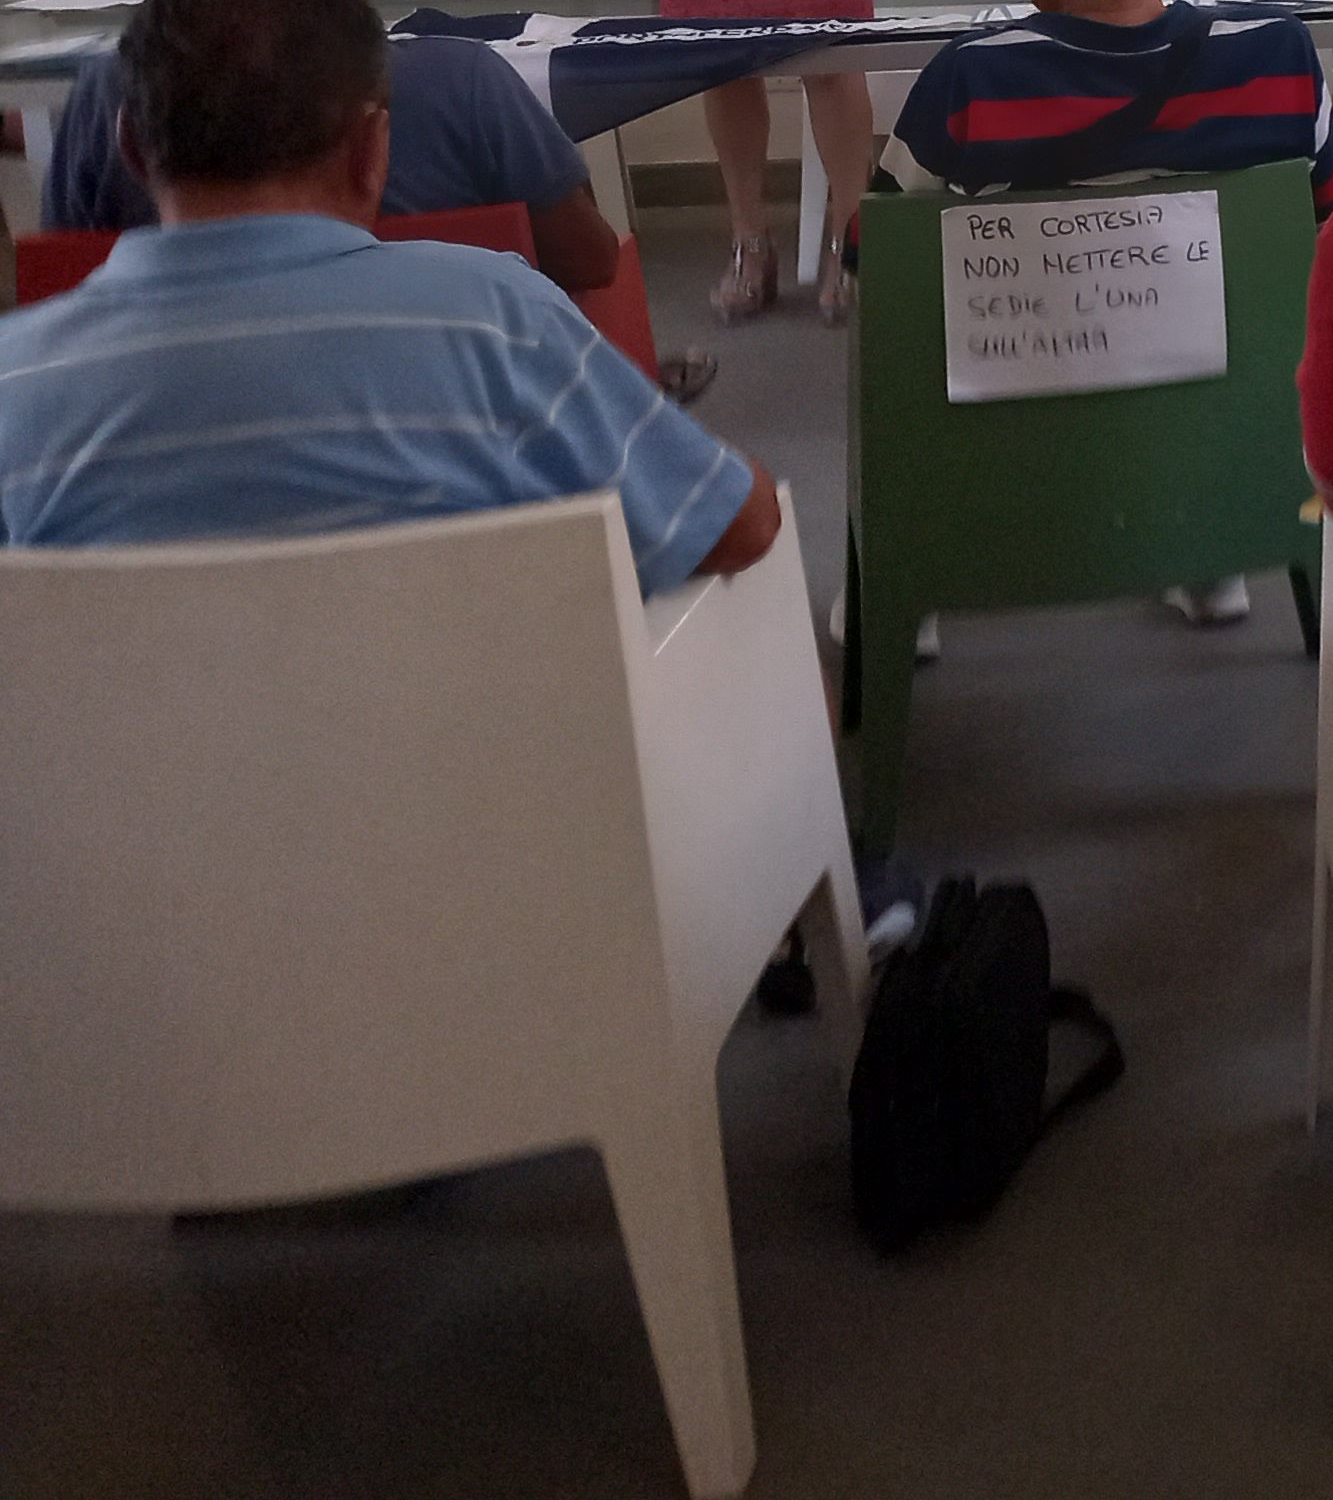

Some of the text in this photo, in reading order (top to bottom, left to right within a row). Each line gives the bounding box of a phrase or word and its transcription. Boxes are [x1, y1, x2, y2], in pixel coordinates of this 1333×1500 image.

[967, 205, 1164, 241] PER CORTESIA
[963, 240, 1210, 280] NON METTERE LE
[1075, 283, 1160, 314] L'UNA
